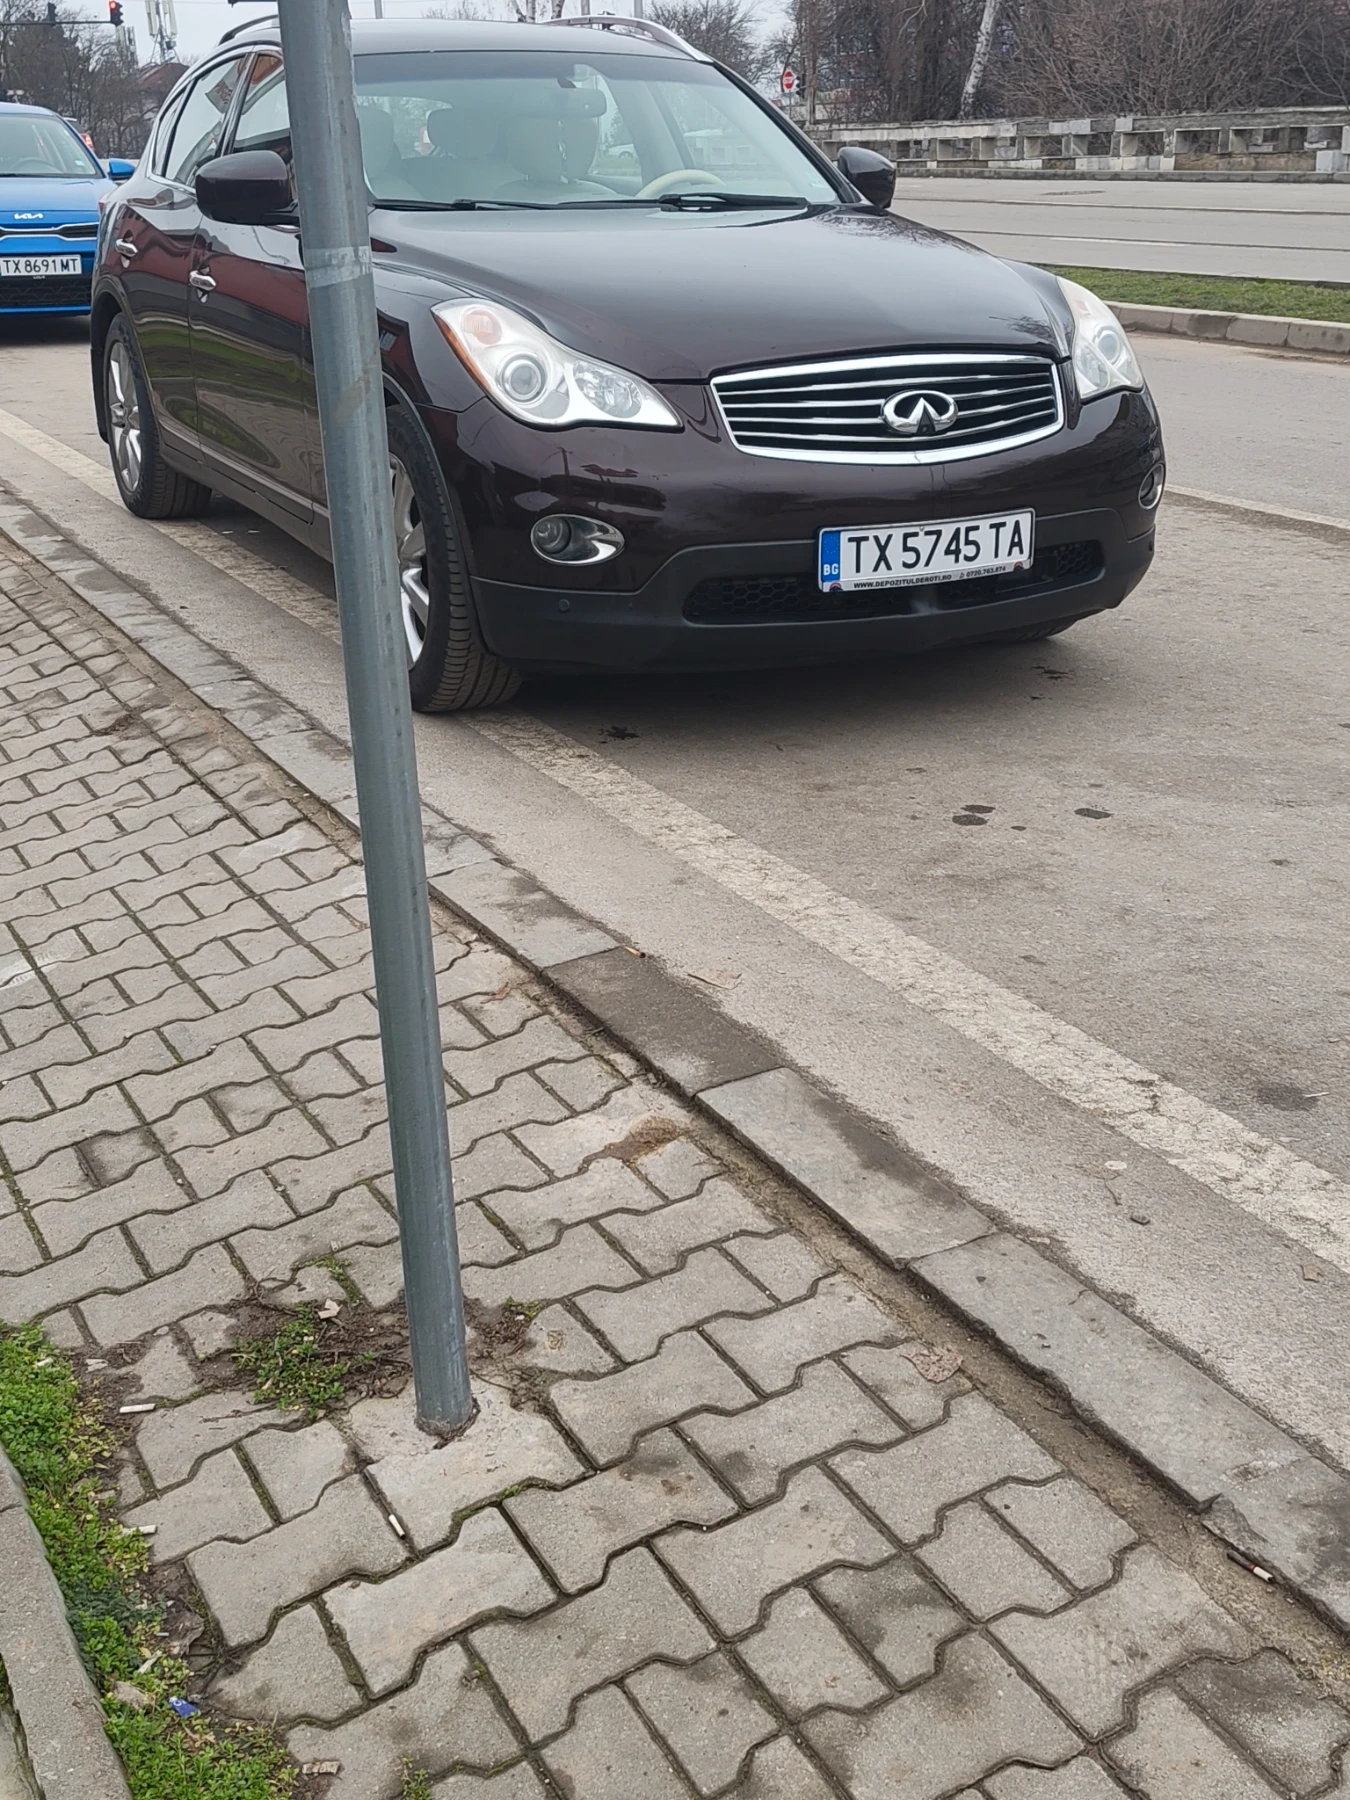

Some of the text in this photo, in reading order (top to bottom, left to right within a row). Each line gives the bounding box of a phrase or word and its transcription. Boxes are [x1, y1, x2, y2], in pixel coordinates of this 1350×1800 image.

[2, 258, 79, 274] TX 8691 MT
[847, 519, 1024, 574] TX 5745 TA
[823, 563, 839, 576] BG
[853, 574, 952, 589] WWW.DEPOZITULDEROTI.RO
